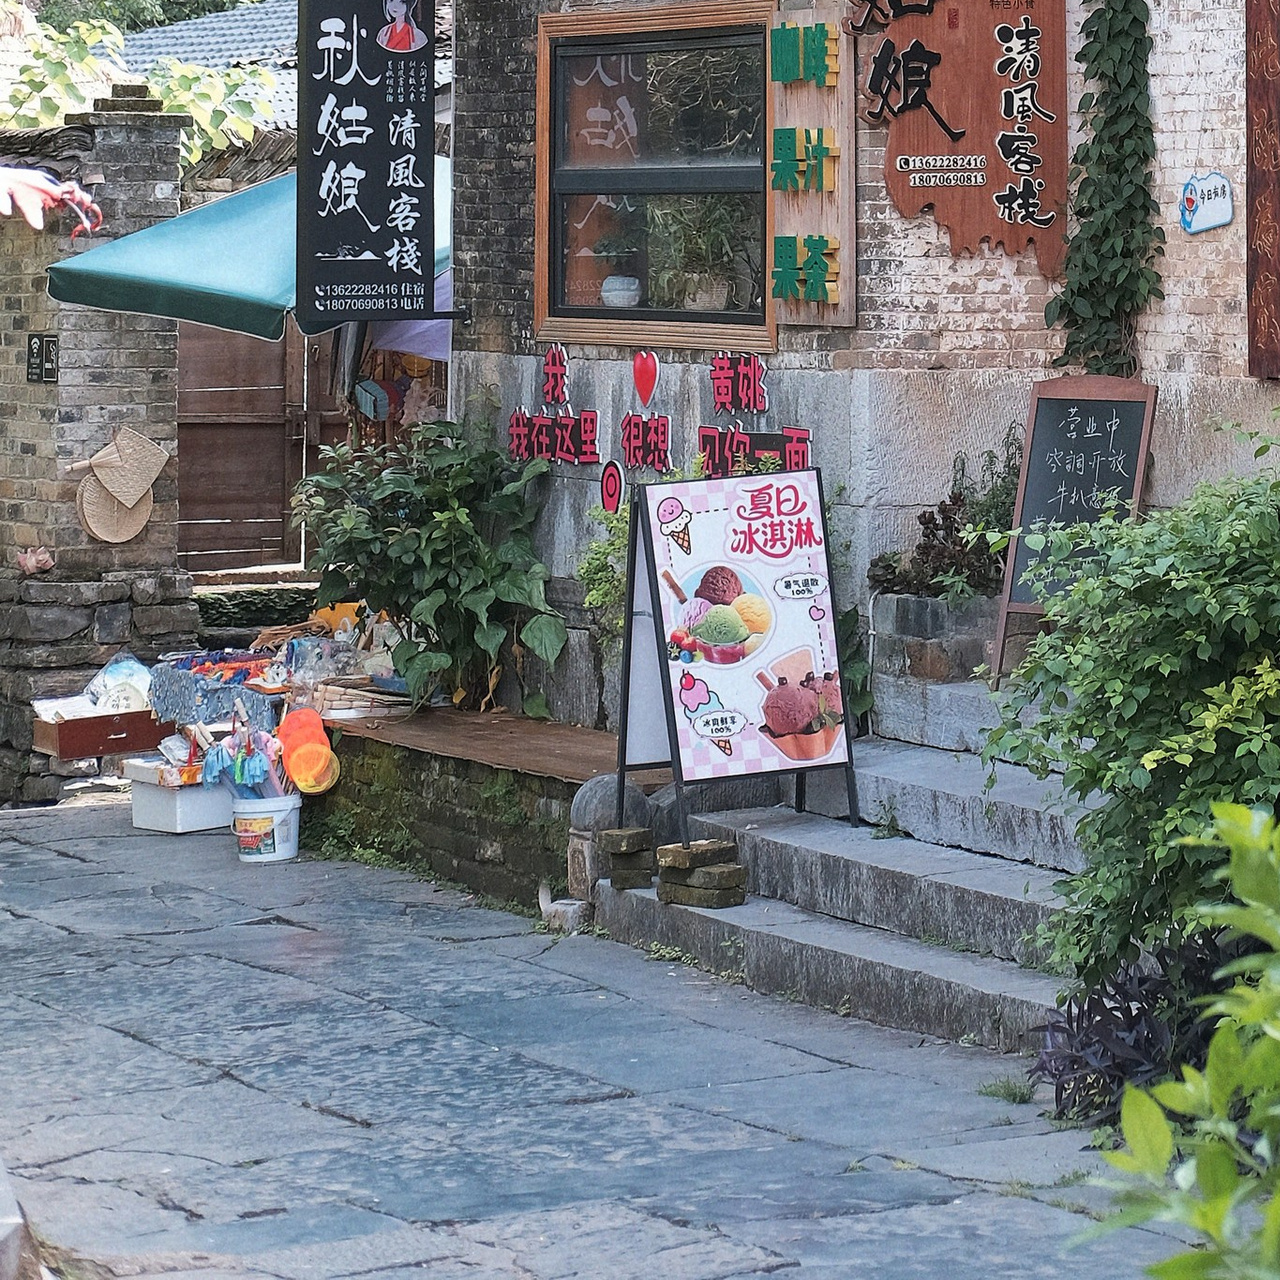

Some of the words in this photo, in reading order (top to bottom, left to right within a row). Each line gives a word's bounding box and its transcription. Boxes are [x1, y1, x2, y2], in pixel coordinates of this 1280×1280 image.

[770, 22, 833, 88] 咖啡
[312, 12, 383, 233] 秋姑娘
[770, 127, 833, 192] 果汁
[908, 171, 987, 188] 18070690813
[910, 154, 988, 172] 13622282416
[325, 284, 398, 297] 13622282416
[401, 282, 425, 297] 住宿
[770, 235, 833, 302] 果茶
[325, 298, 398, 311] 18070690813
[400, 297, 425, 311] 电话
[542, 342, 569, 405] 我
[710, 351, 768, 415] 黄姚
[508, 405, 600, 466] 我在这里
[621, 411, 673, 473] 很想
[1058, 406, 1121, 451] 营业中
[736, 483, 807, 522] 夏日
[730, 517, 823, 559] 冰淇淋
[791, 588, 813, 596] 100%
[710, 725, 732, 734] 100%
